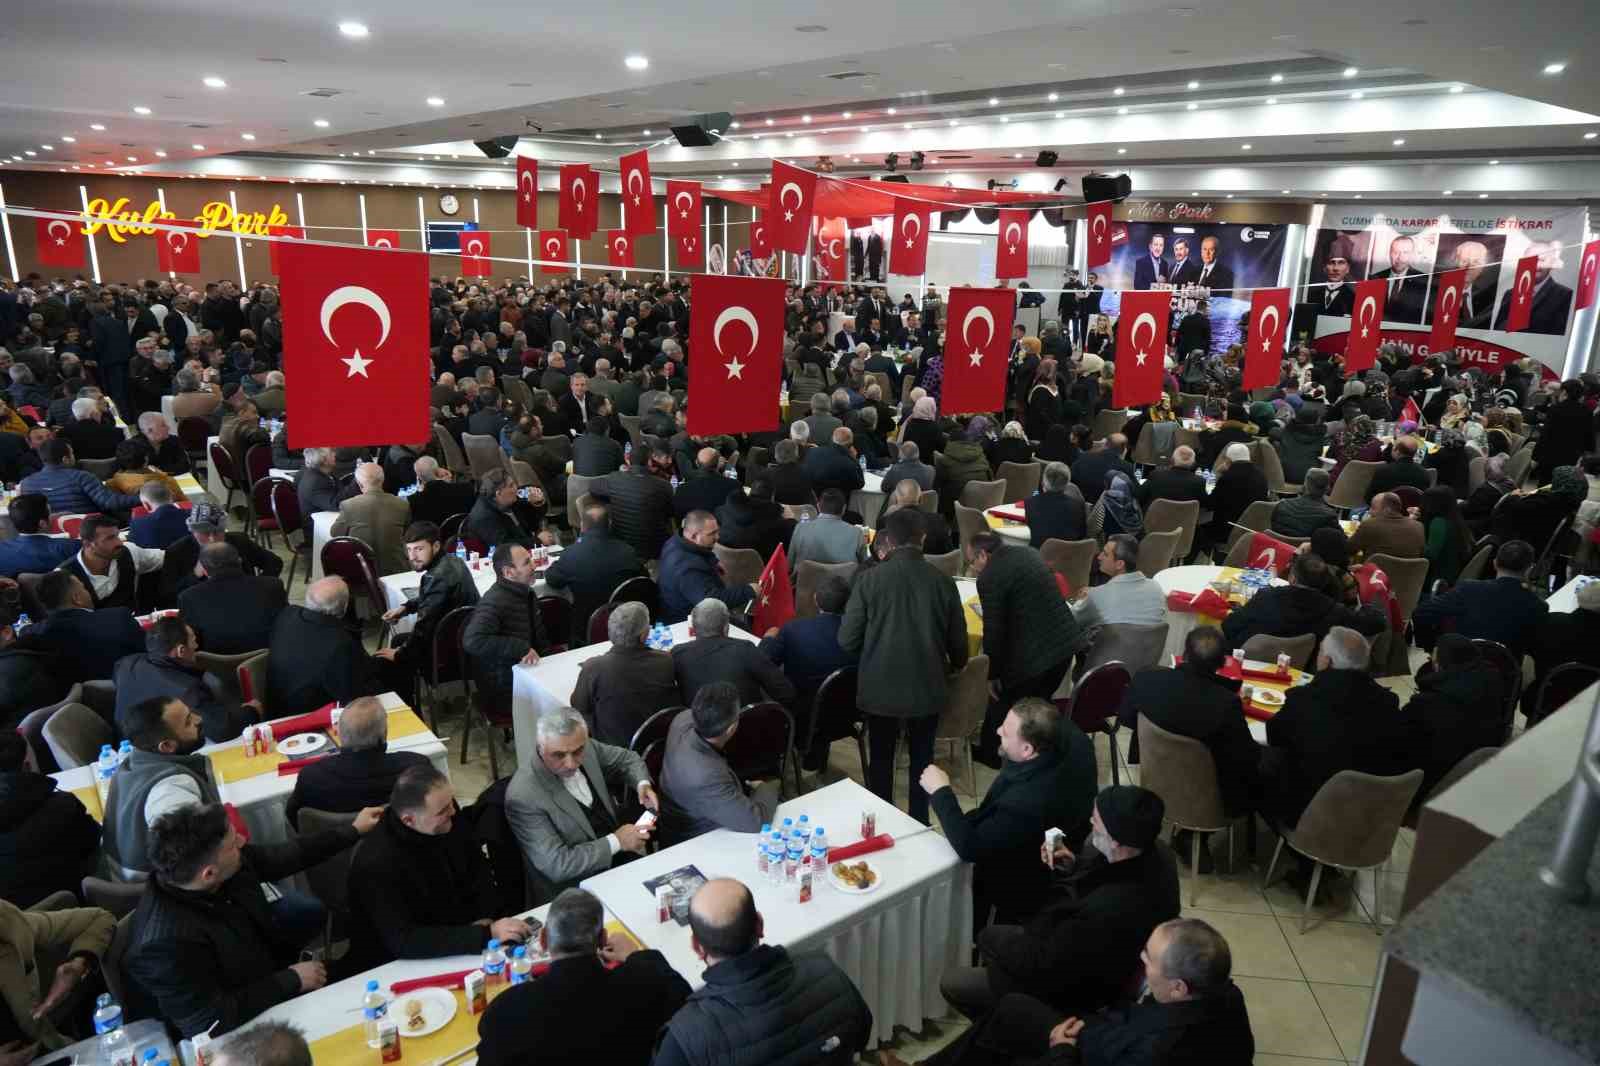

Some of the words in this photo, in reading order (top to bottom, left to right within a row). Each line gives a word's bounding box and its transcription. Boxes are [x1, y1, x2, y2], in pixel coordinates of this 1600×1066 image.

[194, 202, 288, 238] Park
[1342, 216, 1399, 226] CUMHDA
[1444, 218, 1493, 229] ERELDE
[1417, 344, 1500, 363] GÜYLE
